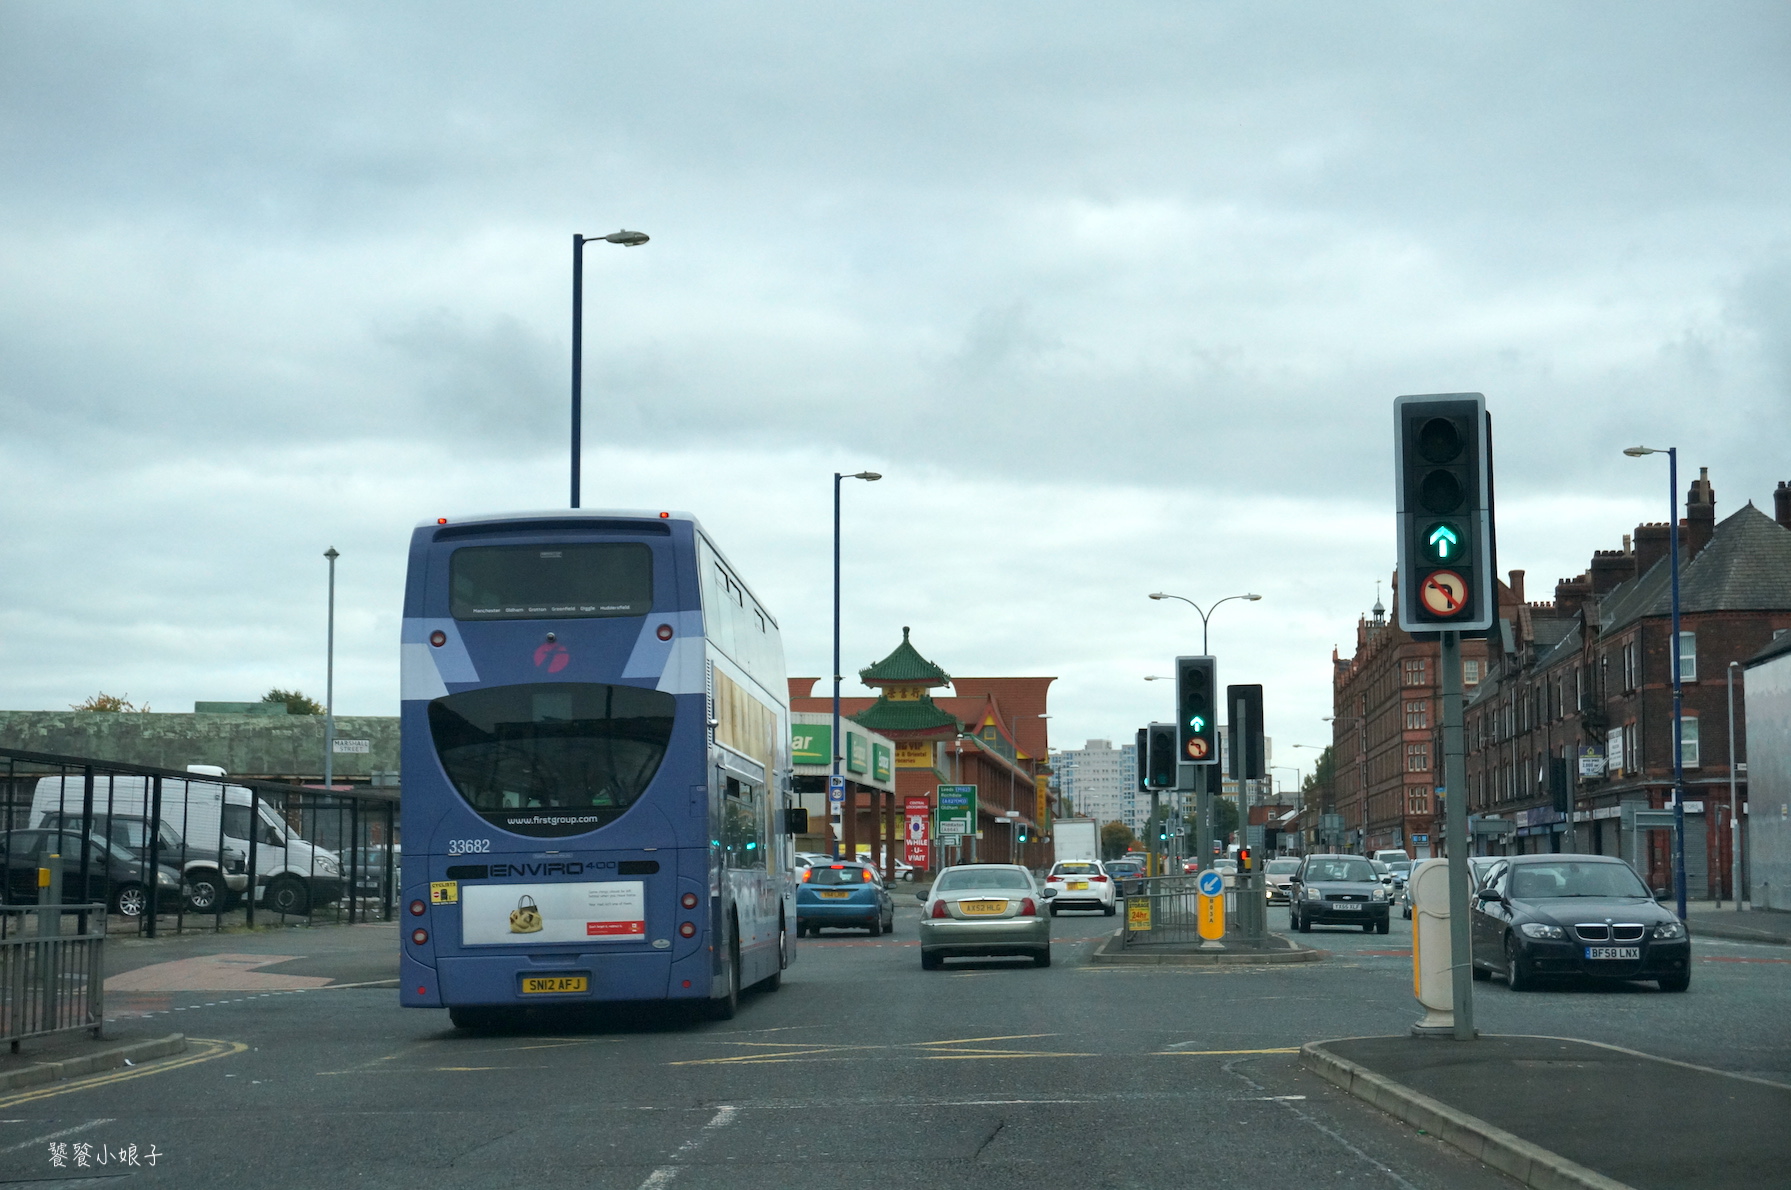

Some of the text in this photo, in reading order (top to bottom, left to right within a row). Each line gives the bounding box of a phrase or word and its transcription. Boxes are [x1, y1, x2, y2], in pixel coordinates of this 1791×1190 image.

[507, 816, 598, 826] www.firstgroup.com
[448, 839, 490, 853] 33682
[490, 863, 584, 877] ENVIRO
[1592, 948, 1638, 958] BF58 LNX
[530, 979, 580, 990] SN12 AFJ
